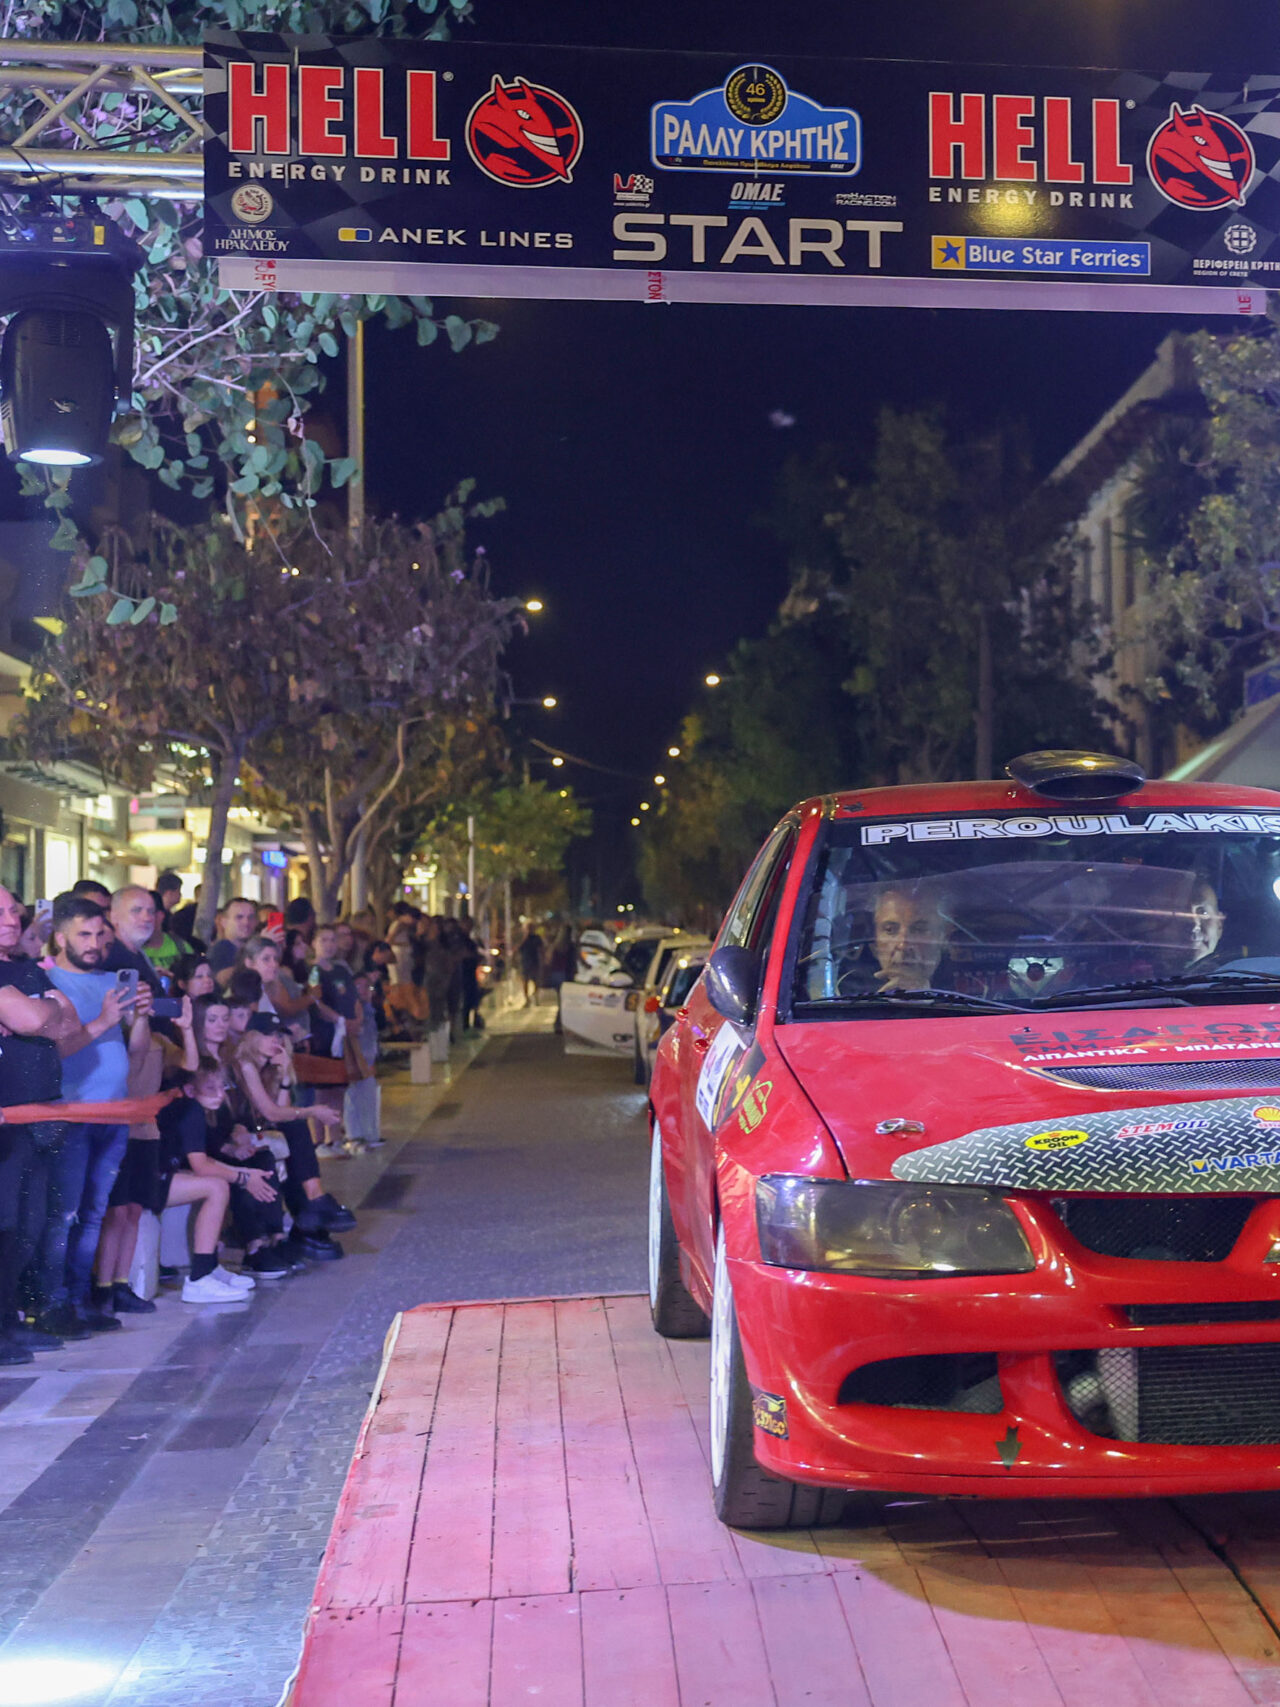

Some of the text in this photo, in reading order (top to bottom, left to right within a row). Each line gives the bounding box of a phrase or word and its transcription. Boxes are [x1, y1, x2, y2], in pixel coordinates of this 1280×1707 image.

[746, 83, 766, 96] 46
[228, 62, 451, 161] HELL
[664, 113, 849, 160] ΡΑΛΛΥ ΚΡΗΤΗΣ
[928, 91, 1133, 185] HELL
[228, 162, 451, 186] ENERGY DRINK
[928, 187, 1134, 209] ENERGY DRINK
[215, 239, 290, 251] ΗΡΑΚΛΕΙΟΥ
[229, 229, 276, 240] ΔΗΜΟΣ
[379, 227, 573, 249] ANEK LINES
[613, 213, 903, 268] START
[968, 245, 1141, 268] Blue Star Ferries
[1193, 259, 1249, 270] ΠΕΡΙΦΕΡΕΙΑ
[1023, 1048, 1148, 1062] ΛΙΠΑΝΤΙΚΑ
[1121, 1120, 1208, 1134] STEMOIL
[1034, 1134, 1079, 1145] KROON
